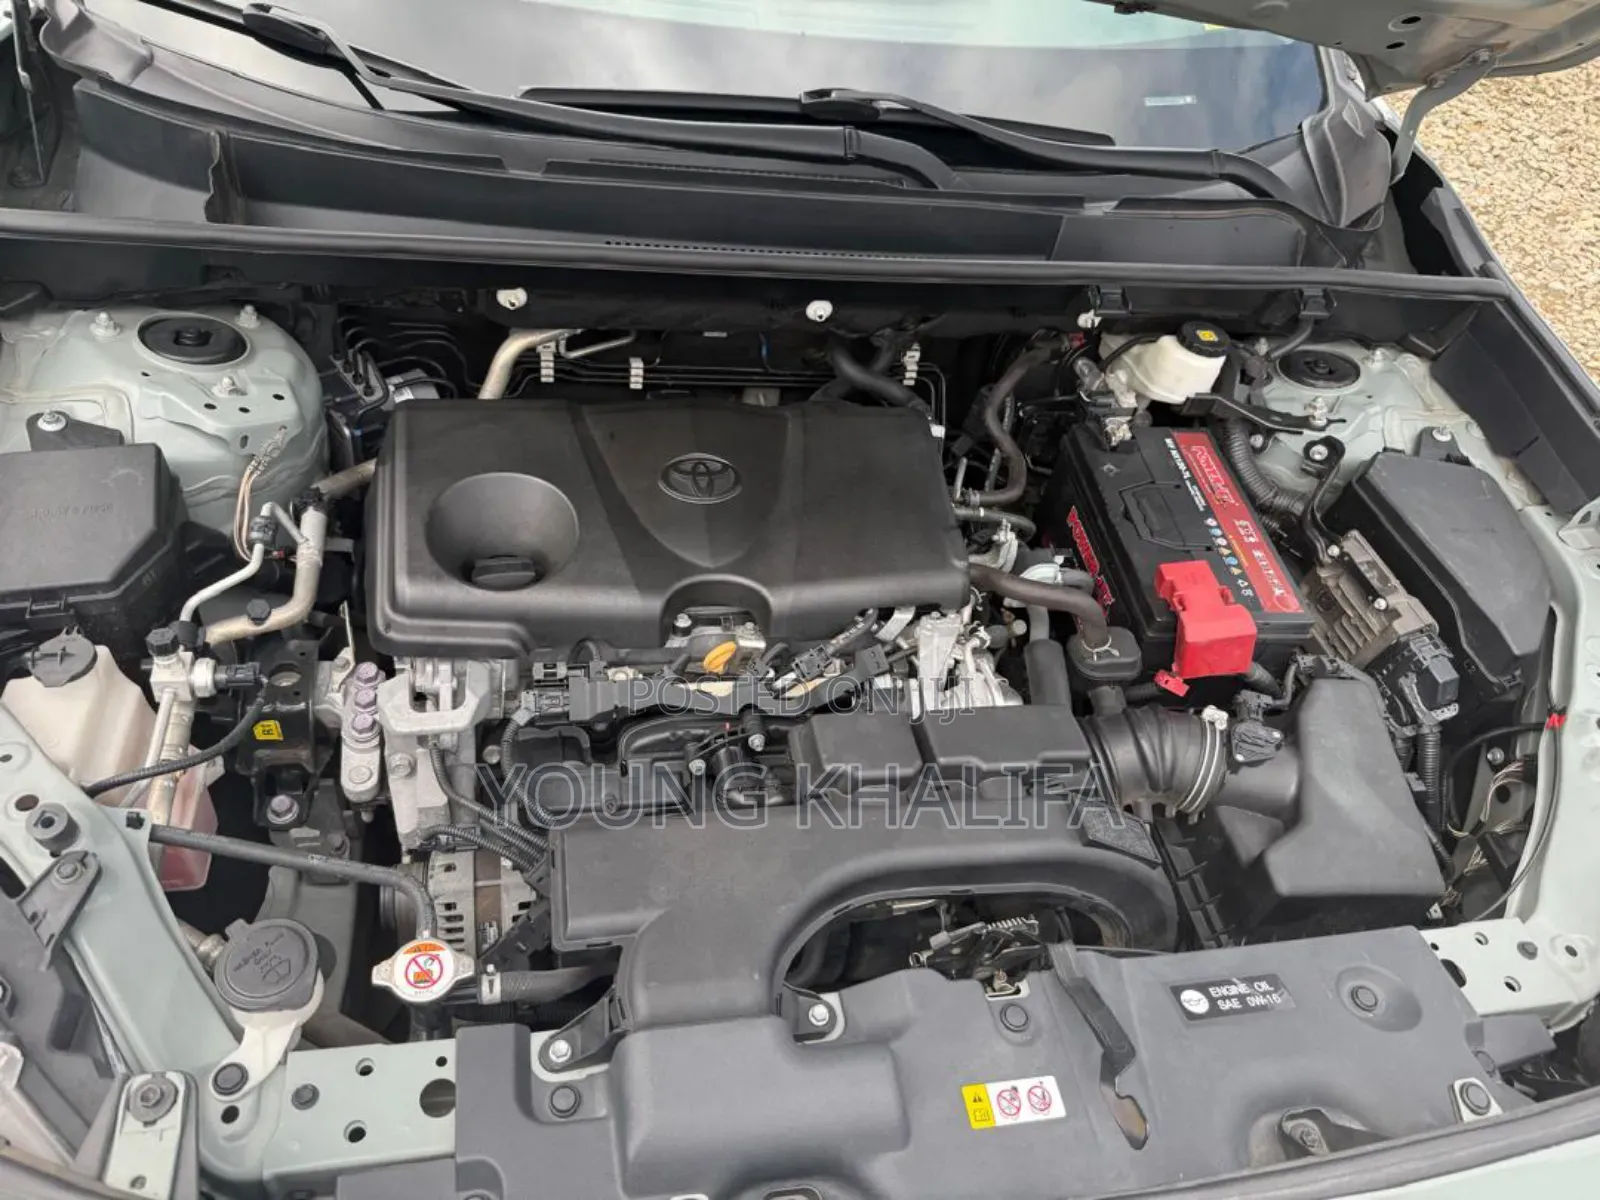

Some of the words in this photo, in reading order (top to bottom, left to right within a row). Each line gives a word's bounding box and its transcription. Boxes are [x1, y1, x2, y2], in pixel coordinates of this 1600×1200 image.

[1208, 983, 1251, 998] ENGINE
[1253, 981, 1275, 992] OIL
[1217, 998, 1242, 1010] SAE
